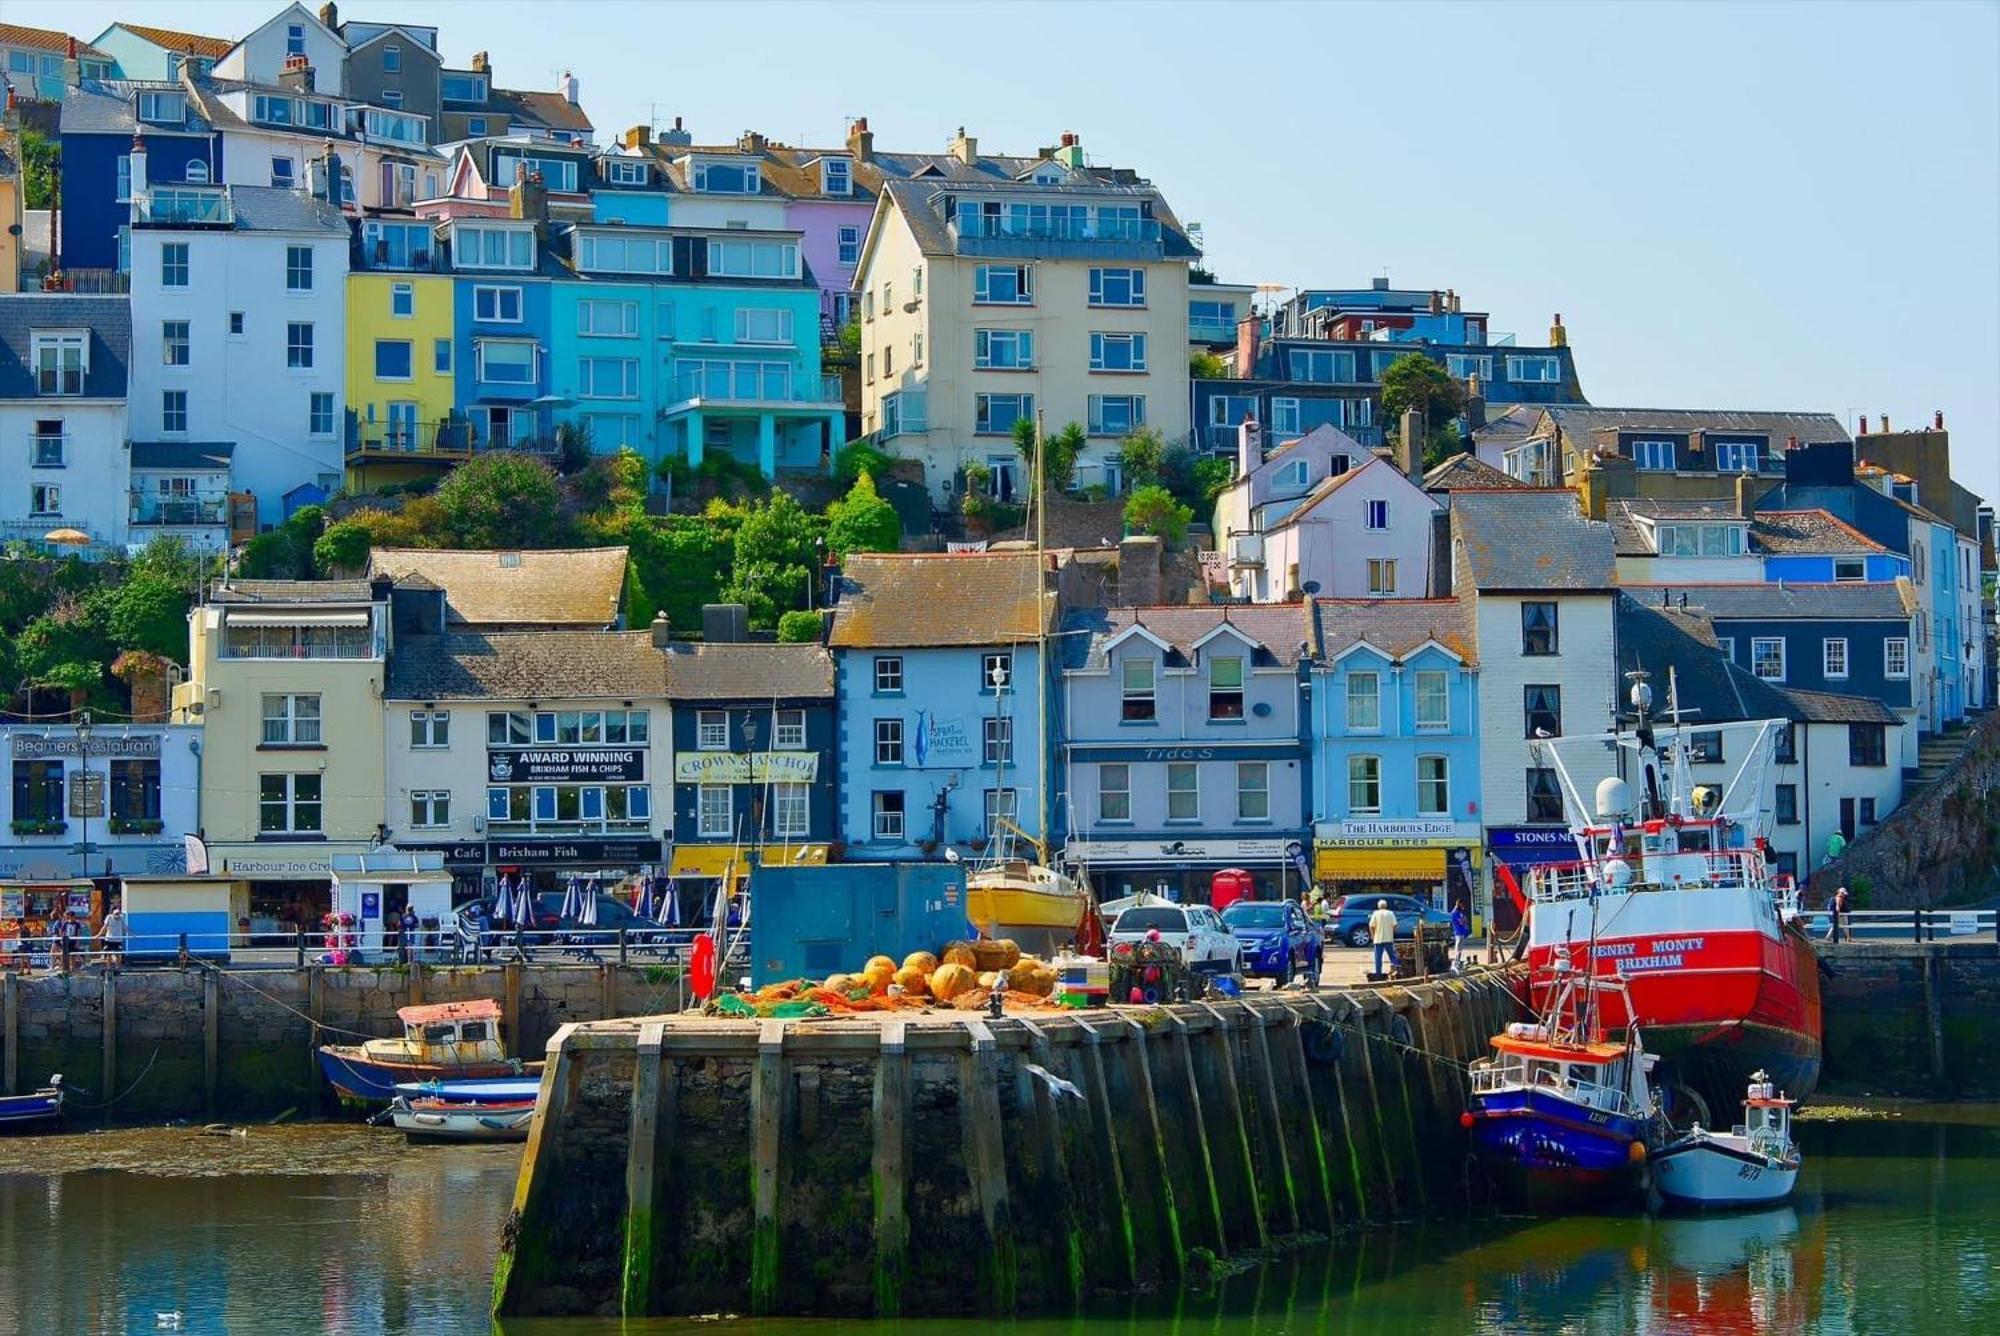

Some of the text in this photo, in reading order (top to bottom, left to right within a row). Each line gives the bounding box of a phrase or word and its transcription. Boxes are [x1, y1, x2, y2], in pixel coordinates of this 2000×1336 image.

[16, 739, 78, 752] Beamers
[519, 752, 569, 763] AWARD
[573, 752, 633, 762] WINNING
[1146, 748, 1215, 759] Tides
[530, 764, 623, 773] BRIXHAM FISH & CHIPS
[681, 755, 737, 774] CROWN
[756, 755, 814, 774] ANCHOR
[1344, 823, 1367, 834] THE
[1424, 823, 1453, 833] EDGE
[1320, 839, 1385, 847] HARBOUR
[1391, 839, 1429, 847] BITES
[1515, 832, 1556, 843] STONES
[499, 846, 578, 857] Brixham Fish
[232, 862, 331, 871] Harbour Ice Cre
[1652, 938, 1704, 953] MONTY
[1615, 954, 1682, 969] BRIXHAM
